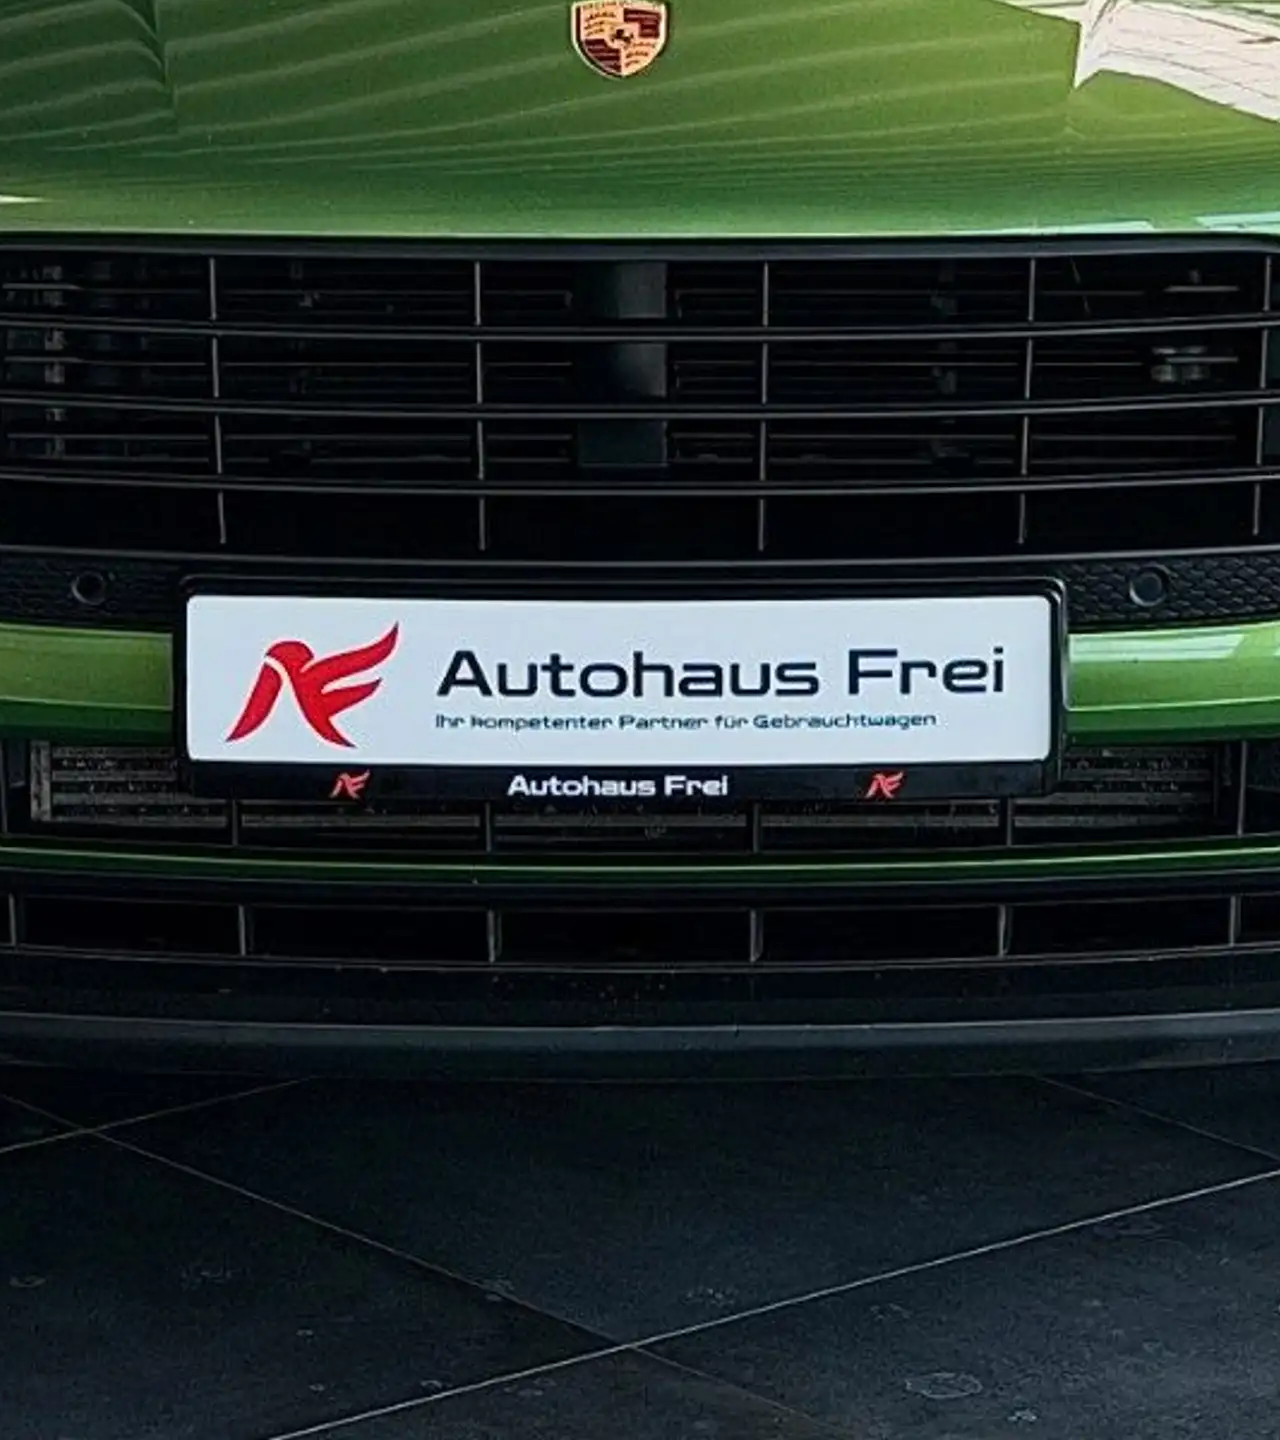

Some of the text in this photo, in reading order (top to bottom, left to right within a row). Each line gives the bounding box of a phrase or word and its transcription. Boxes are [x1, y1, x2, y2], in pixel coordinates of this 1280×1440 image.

[435, 646, 1004, 698] Autohaus Frei
[435, 714, 466, 729] Ihr
[618, 714, 709, 729] Partner
[714, 714, 749, 729] für
[752, 713, 937, 731] Gebrauchtwagen
[506, 774, 728, 796] Autohaus Frei
